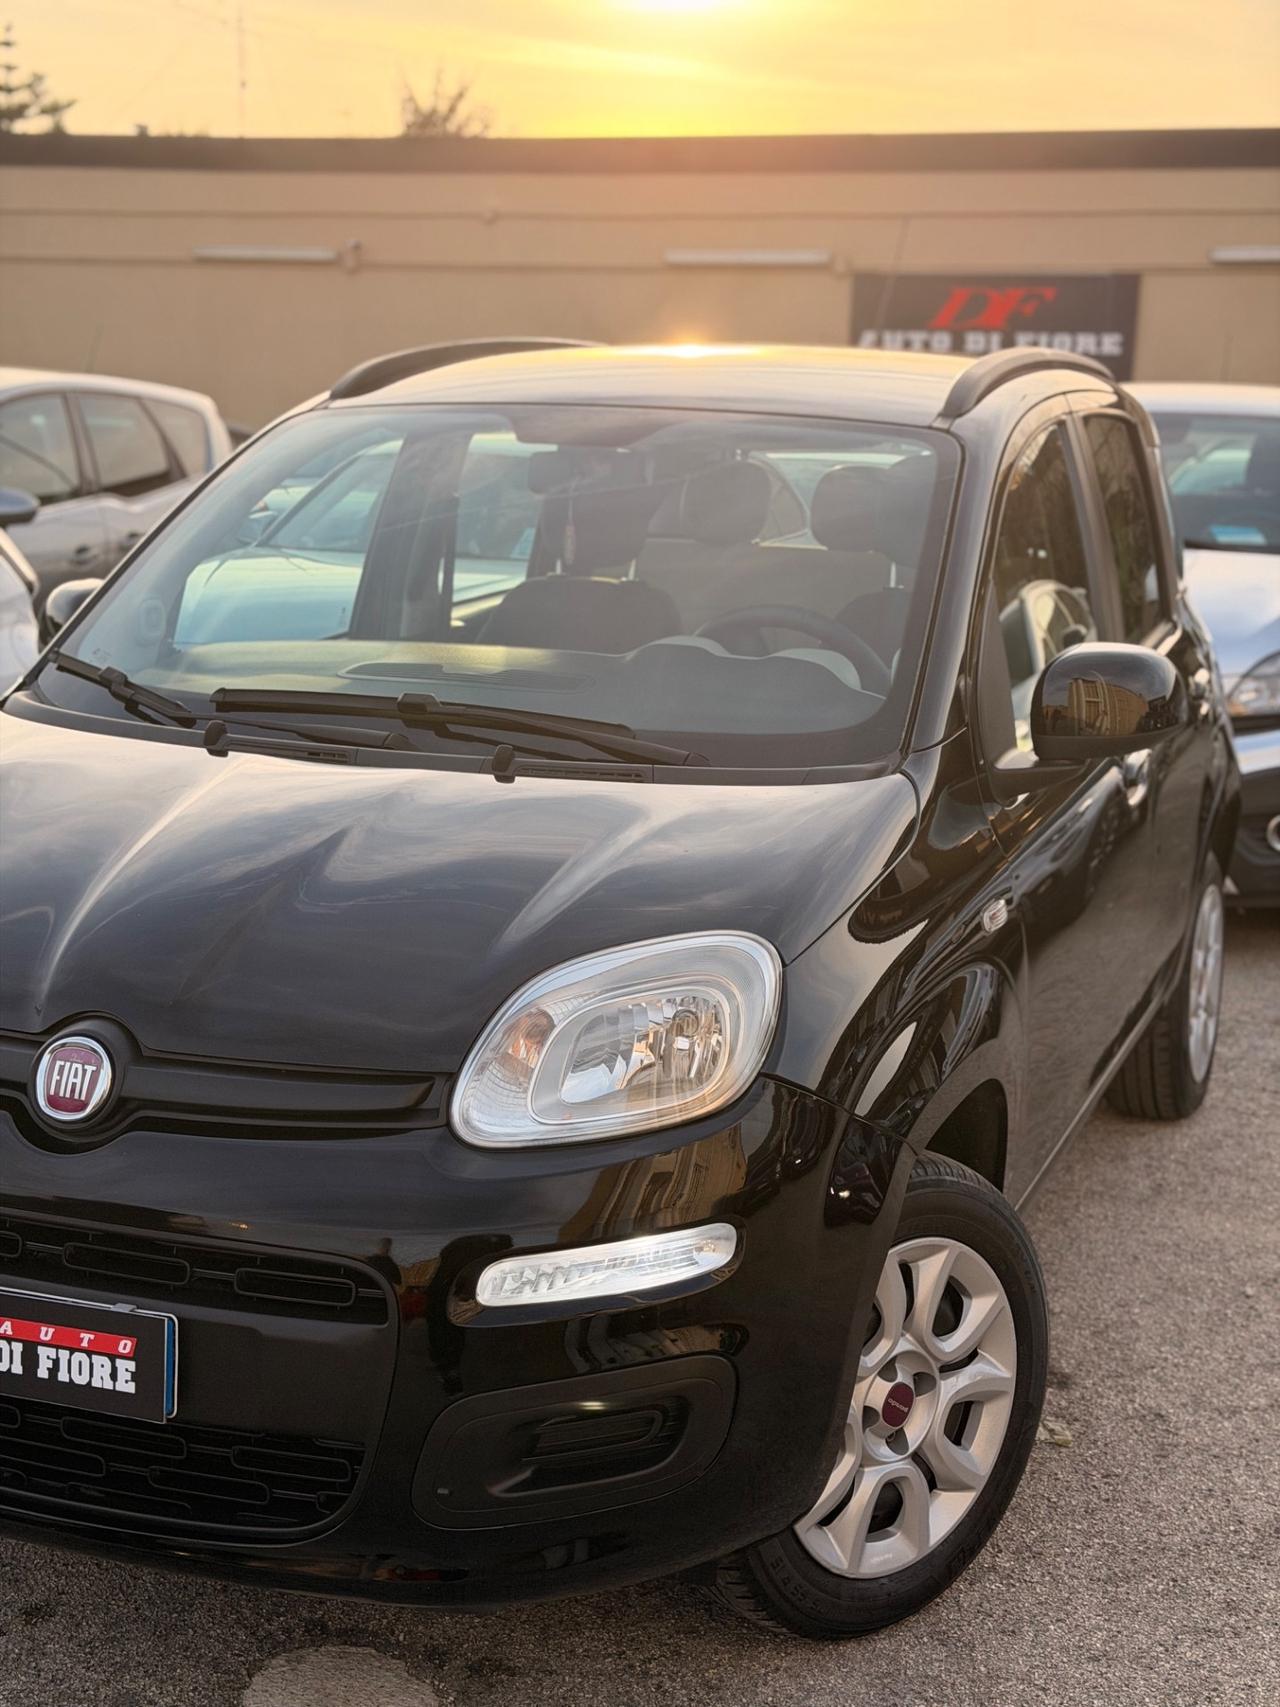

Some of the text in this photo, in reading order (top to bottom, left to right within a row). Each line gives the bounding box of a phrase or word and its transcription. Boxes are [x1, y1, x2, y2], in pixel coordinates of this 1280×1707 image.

[929, 286, 1058, 330] DF
[857, 329, 1125, 357] AUTO DI FIORE
[49, 1060, 97, 1101] FIAT
[0, 1320, 133, 1354] AUTO
[36, 1345, 137, 1394] FIORE
